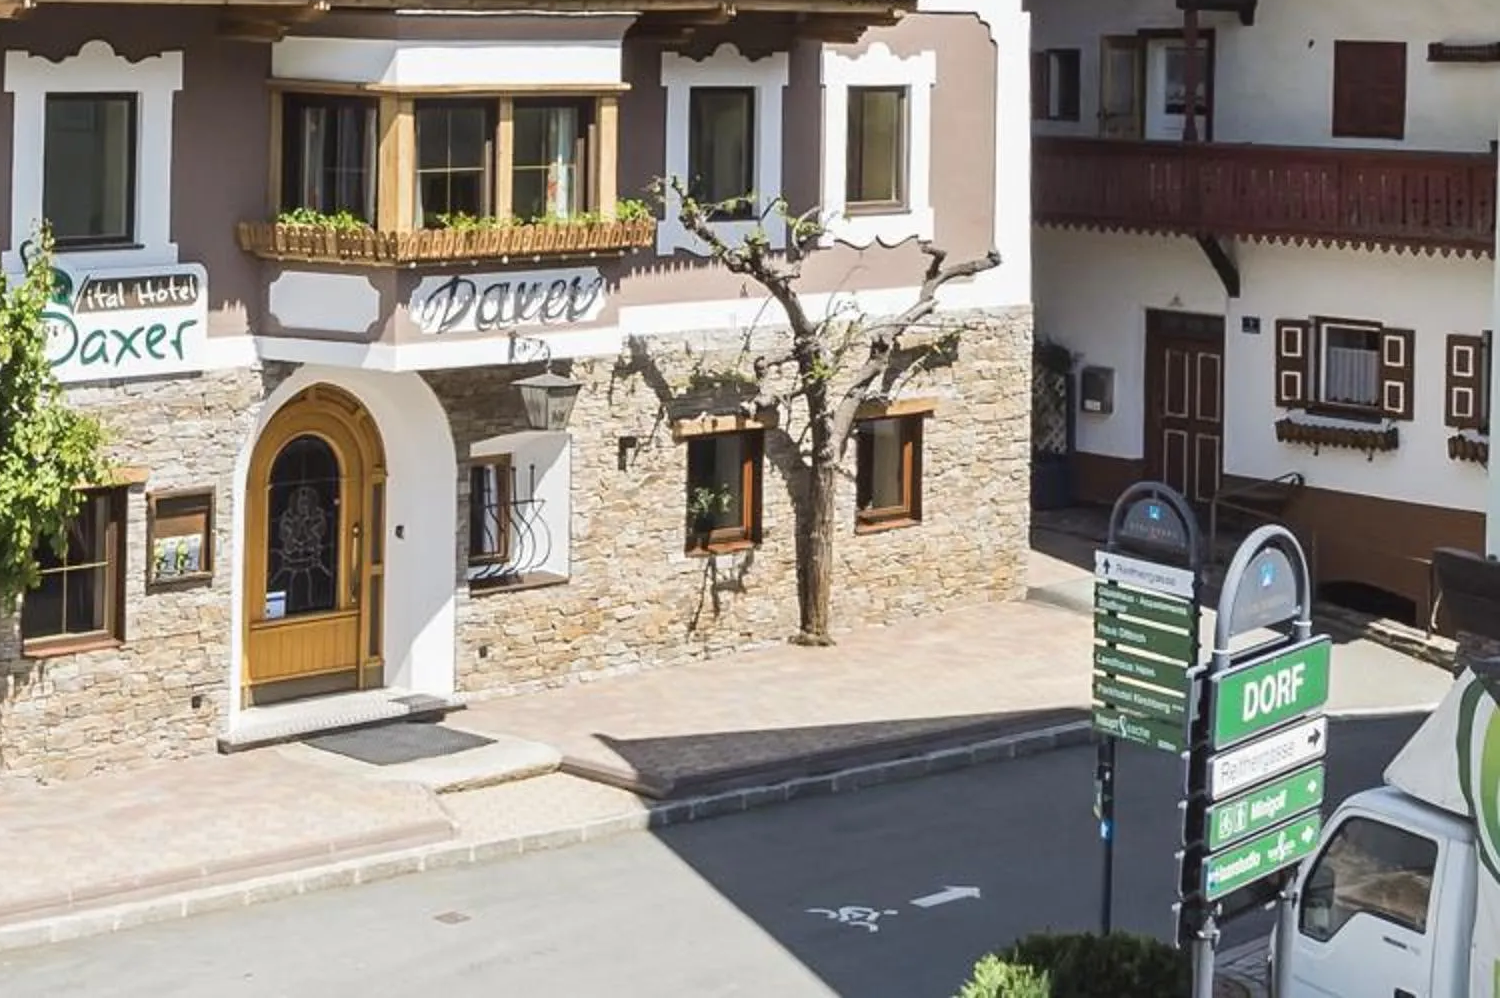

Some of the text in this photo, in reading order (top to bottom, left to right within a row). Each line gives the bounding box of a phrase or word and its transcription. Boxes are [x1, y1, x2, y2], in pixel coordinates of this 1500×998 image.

[137, 275, 198, 305] Hotel
[38, 310, 199, 368] Daxer
[1242, 662, 1306, 722] DORF
